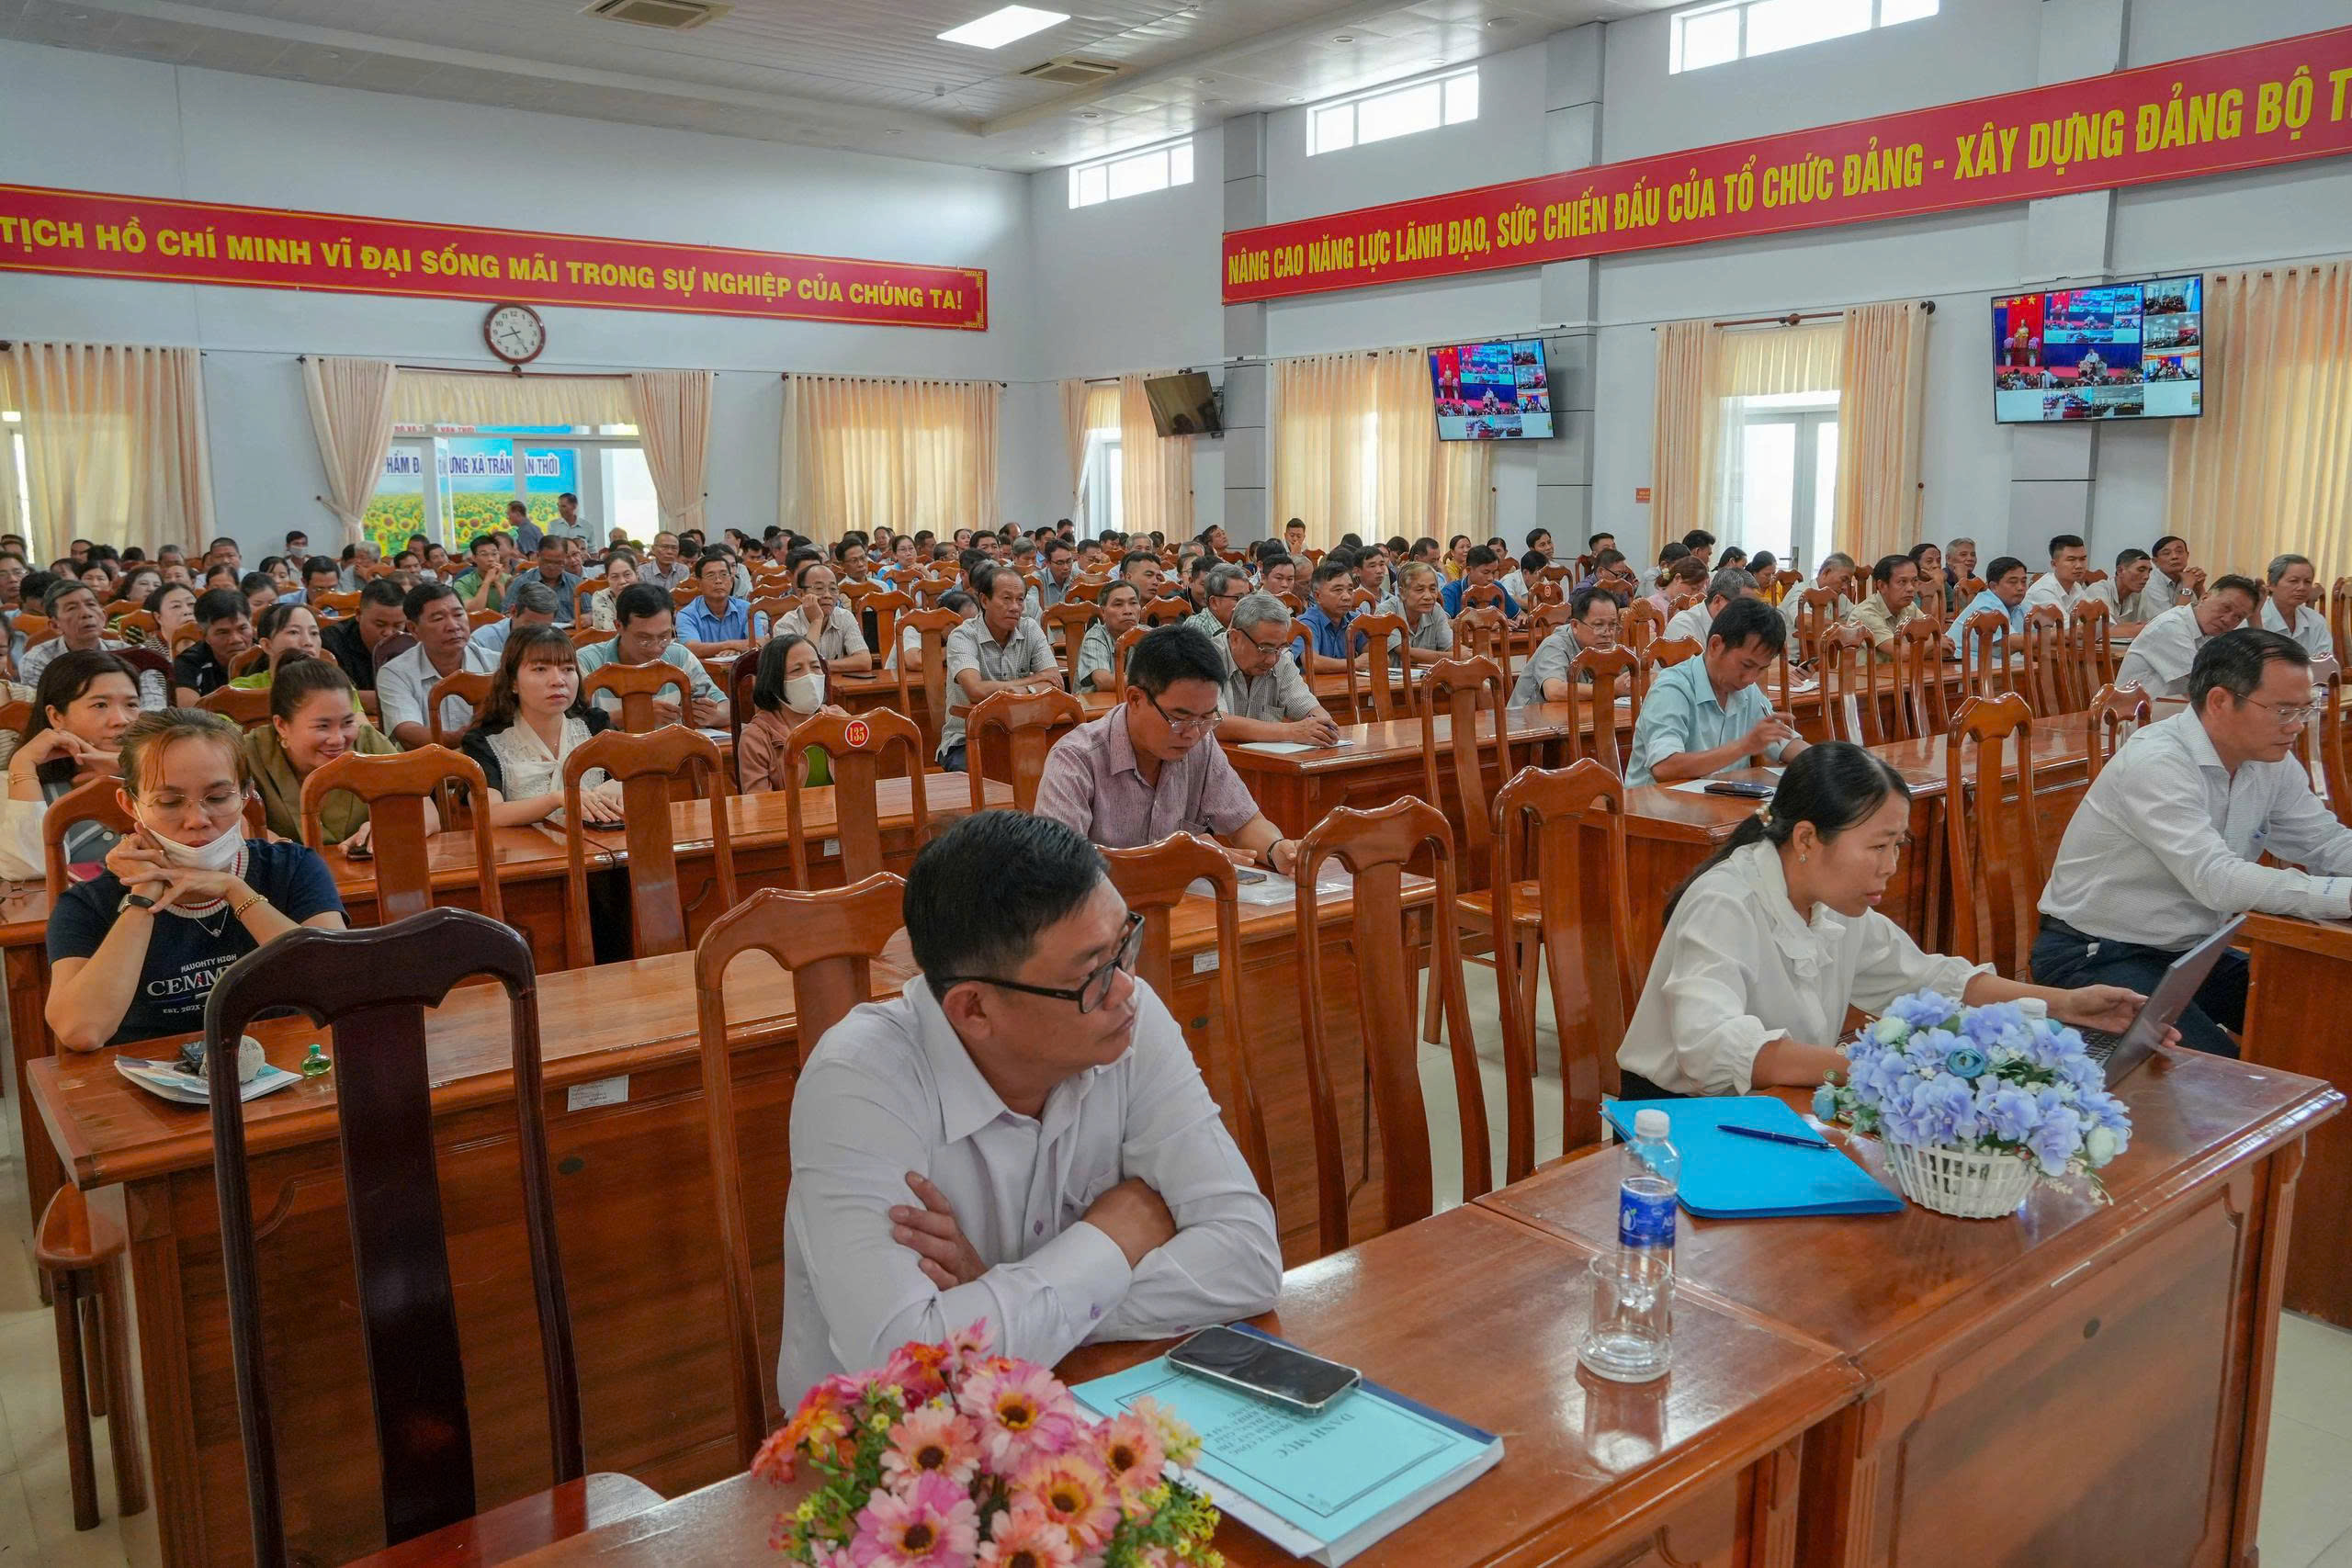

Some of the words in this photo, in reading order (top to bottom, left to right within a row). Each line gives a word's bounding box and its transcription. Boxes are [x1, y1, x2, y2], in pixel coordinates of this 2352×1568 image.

[1227, 247, 1270, 285] NÂNG
[1273, 244, 1305, 277] CAO
[1308, 231, 1354, 274] NĂNG
[1358, 228, 1391, 276] LỰC
[1395, 220, 1443, 263] LÃNH
[1447, 216, 1491, 261] ĐẠO,
[1496, 202, 1537, 249] SỨC
[1544, 186, 1609, 243] CHIẾN
[1613, 175, 1662, 231] ĐẤU
[1668, 168, 1716, 223] CỦA
[1724, 154, 1757, 214] TỔ
[1762, 152, 1835, 209] CHỨC
[1842, 136, 1924, 197] ĐẢNG
[1932, 159, 1946, 171] -
[1953, 122, 2019, 181] XÂY
[2028, 109, 2125, 175] DỰNG
[2135, 82, 2245, 153] ĐẢNG
[2255, 64, 2314, 141] BỘ
[2329, 67, 2352, 122] T
[0, 216, 85, 253] TỊCH
[95, 216, 146, 254] HỒ
[157, 226, 217, 258] CHÍ
[227, 234, 312, 266] MINH
[320, 237, 353, 269] VĨ
[360, 245, 413, 278] ĐẠI
[421, 243, 501, 279] SỐNG
[508, 253, 559, 283] MÃI
[566, 261, 655, 289] TRONG
[662, 266, 696, 298] SỰ
[702, 271, 792, 303] NGHIỆP
[797, 274, 843, 302] CỦA
[849, 280, 924, 309] CHÚNG
[929, 288, 963, 310] TA!
[386, 449, 410, 474] HẨM
[850, 727, 865, 741] 135
[181, 958, 216, 973] NAUGHTY
[216, 953, 237, 964] HIGH
[147, 965, 229, 997] CEMM
[1310, 1412, 1356, 1439] DANH
